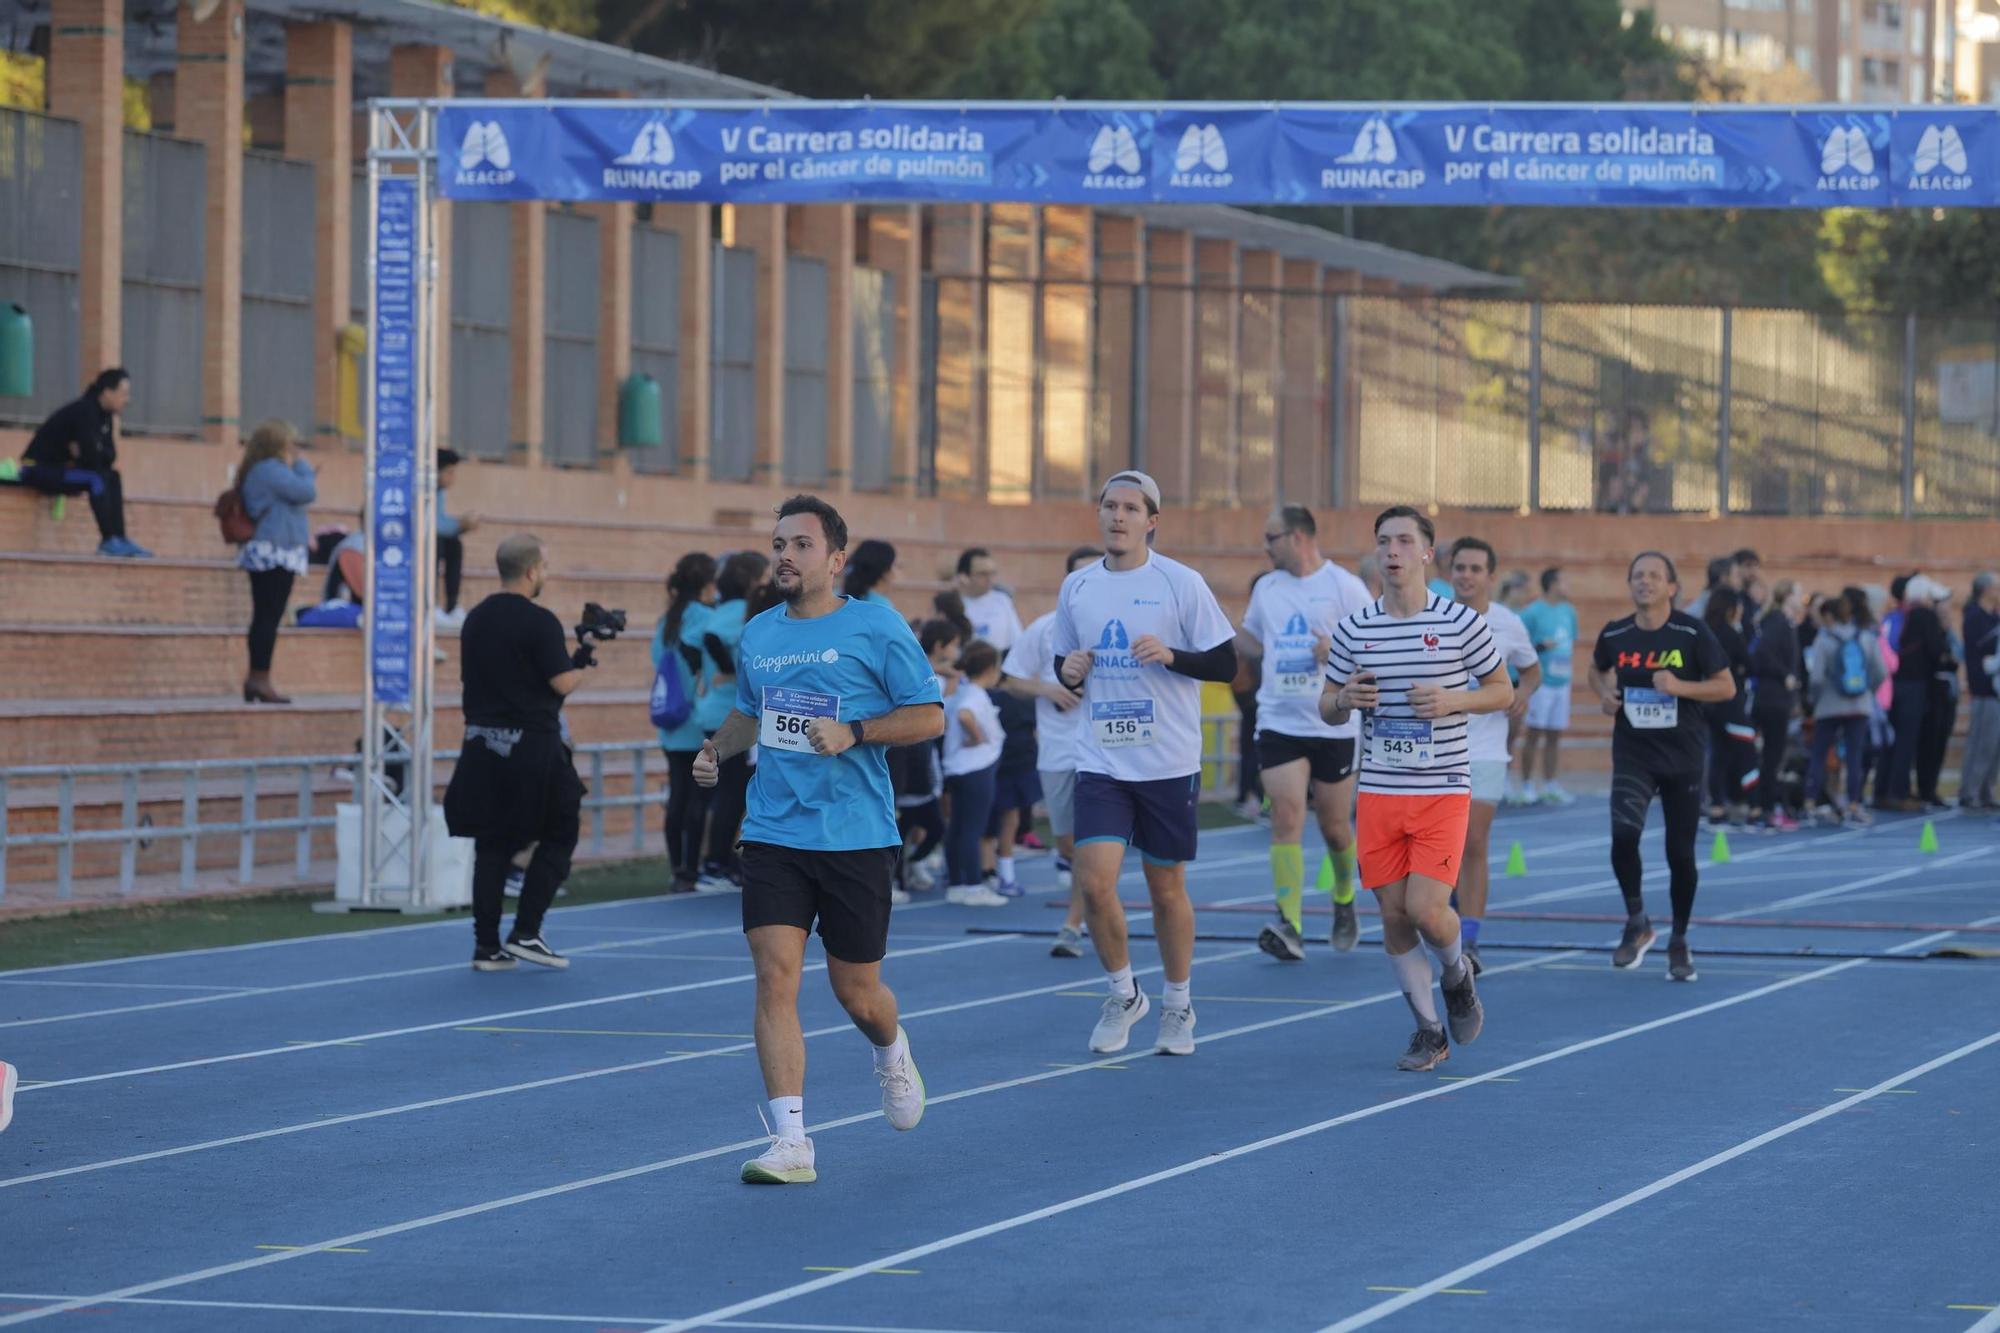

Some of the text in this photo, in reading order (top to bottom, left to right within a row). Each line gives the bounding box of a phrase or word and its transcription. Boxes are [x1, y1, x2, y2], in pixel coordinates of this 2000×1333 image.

[721, 126, 983, 152] V Carrera solidaria
[1444, 126, 1714, 154] V Carrera solidaria
[721, 155, 985, 184] por el cáncer de pulmón
[1444, 158, 1716, 186] por el cáncer de pulmón
[752, 650, 821, 673] Capgemini
[776, 715, 810, 735] 566
[1105, 720, 1136, 734] 156
[1384, 739, 1413, 754] 543
